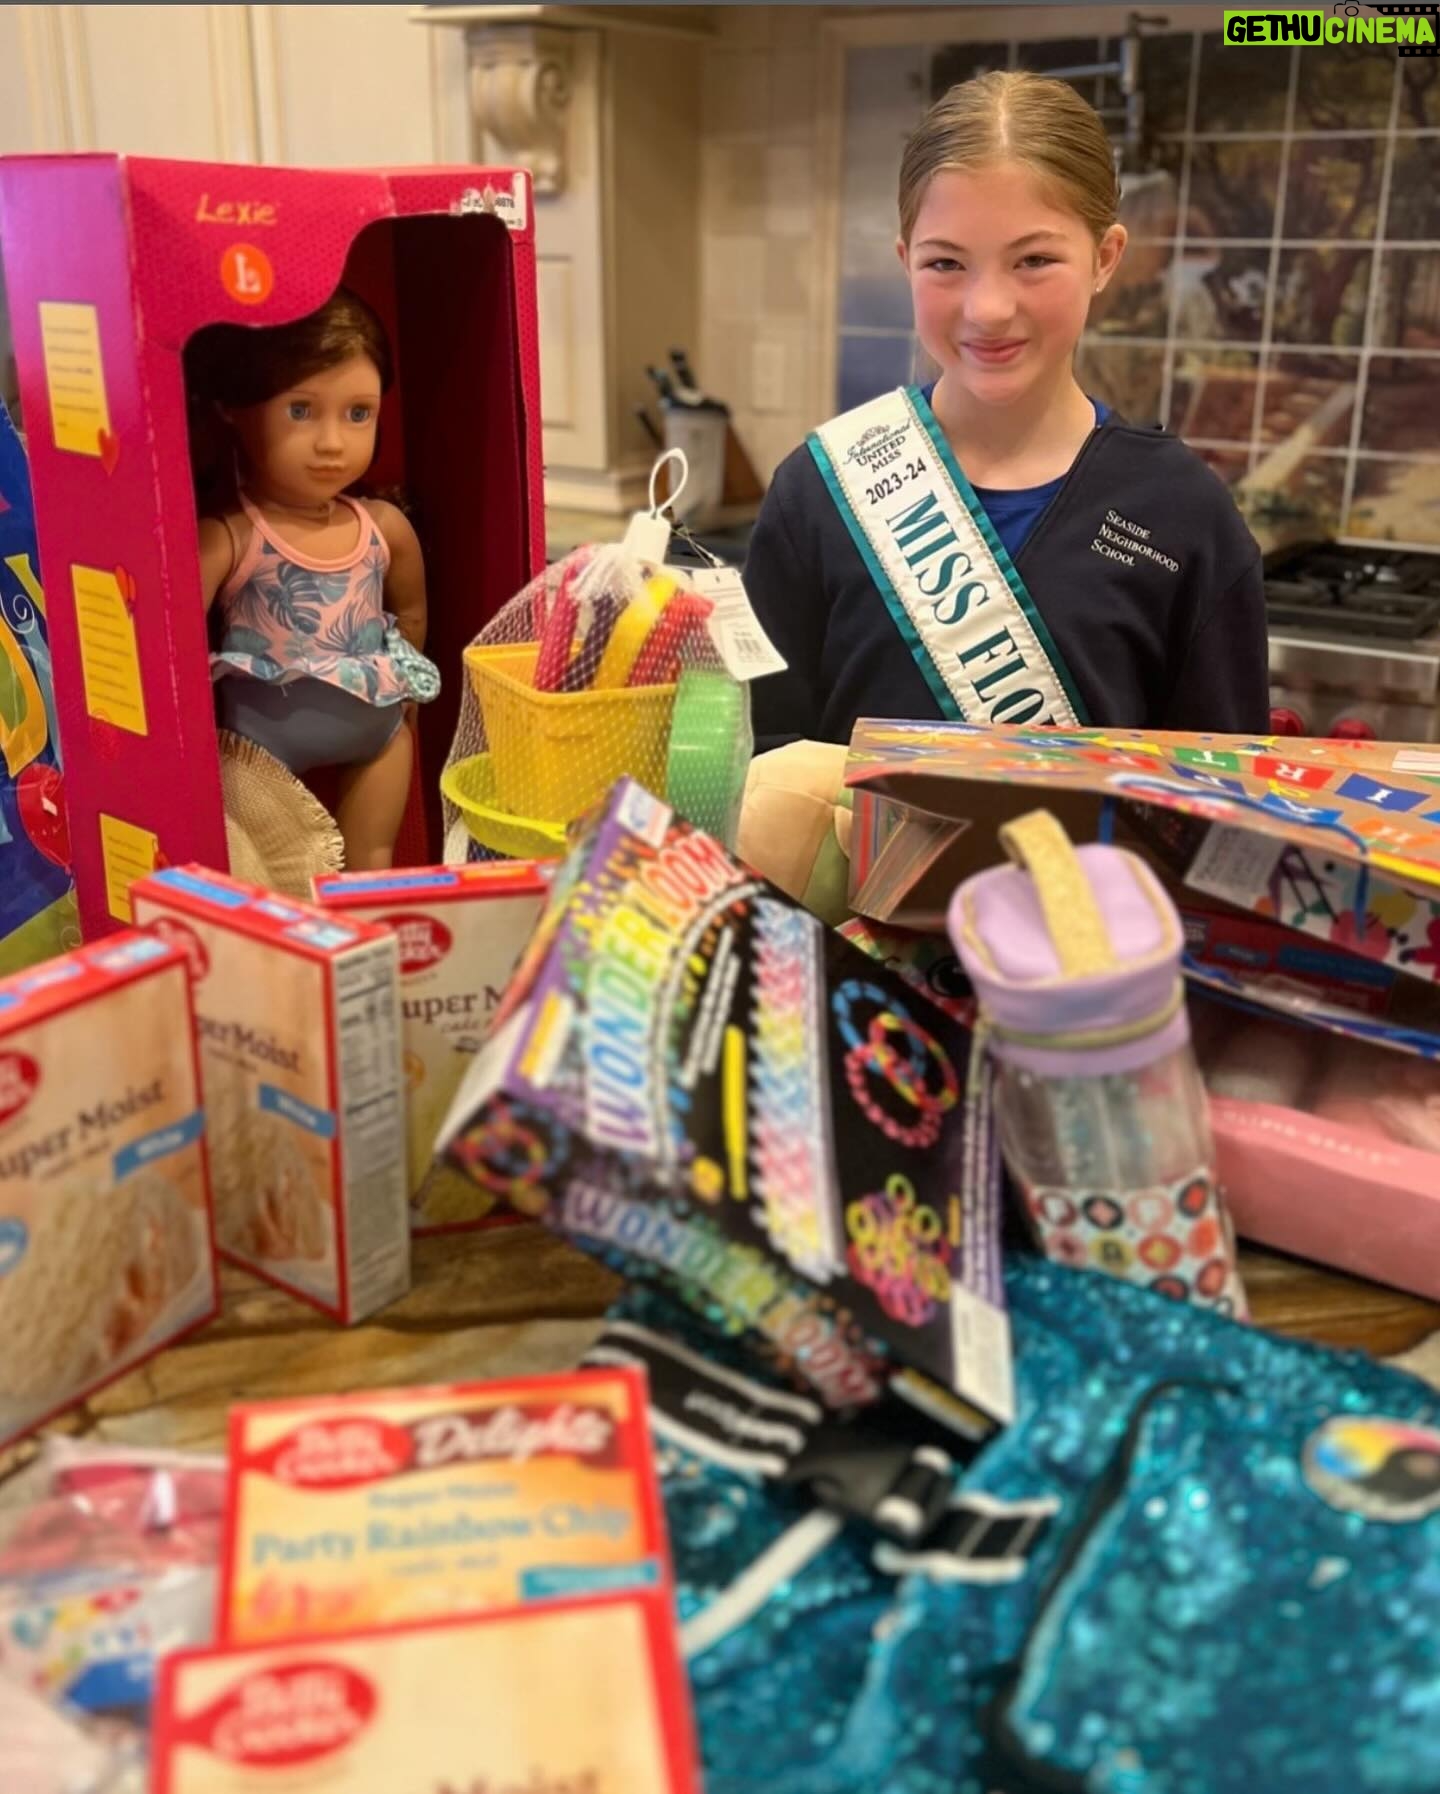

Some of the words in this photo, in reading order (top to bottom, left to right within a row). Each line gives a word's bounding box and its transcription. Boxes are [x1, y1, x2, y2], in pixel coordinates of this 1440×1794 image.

[196, 193, 278, 225] Lexie
[856, 435, 906, 466] UNITED
[871, 448, 902, 473] MISS
[866, 457, 927, 505] 2023-24
[1106, 510, 1151, 540] SEASIDE
[1091, 538, 1136, 567] SCHOOL
[1098, 523, 1179, 572] NEIGHBORHOOD
[885, 489, 990, 625] MISS
[956, 625, 1057, 726] FLO
[402, 990, 477, 1025] uper
[0, 1124, 71, 1180] uper
